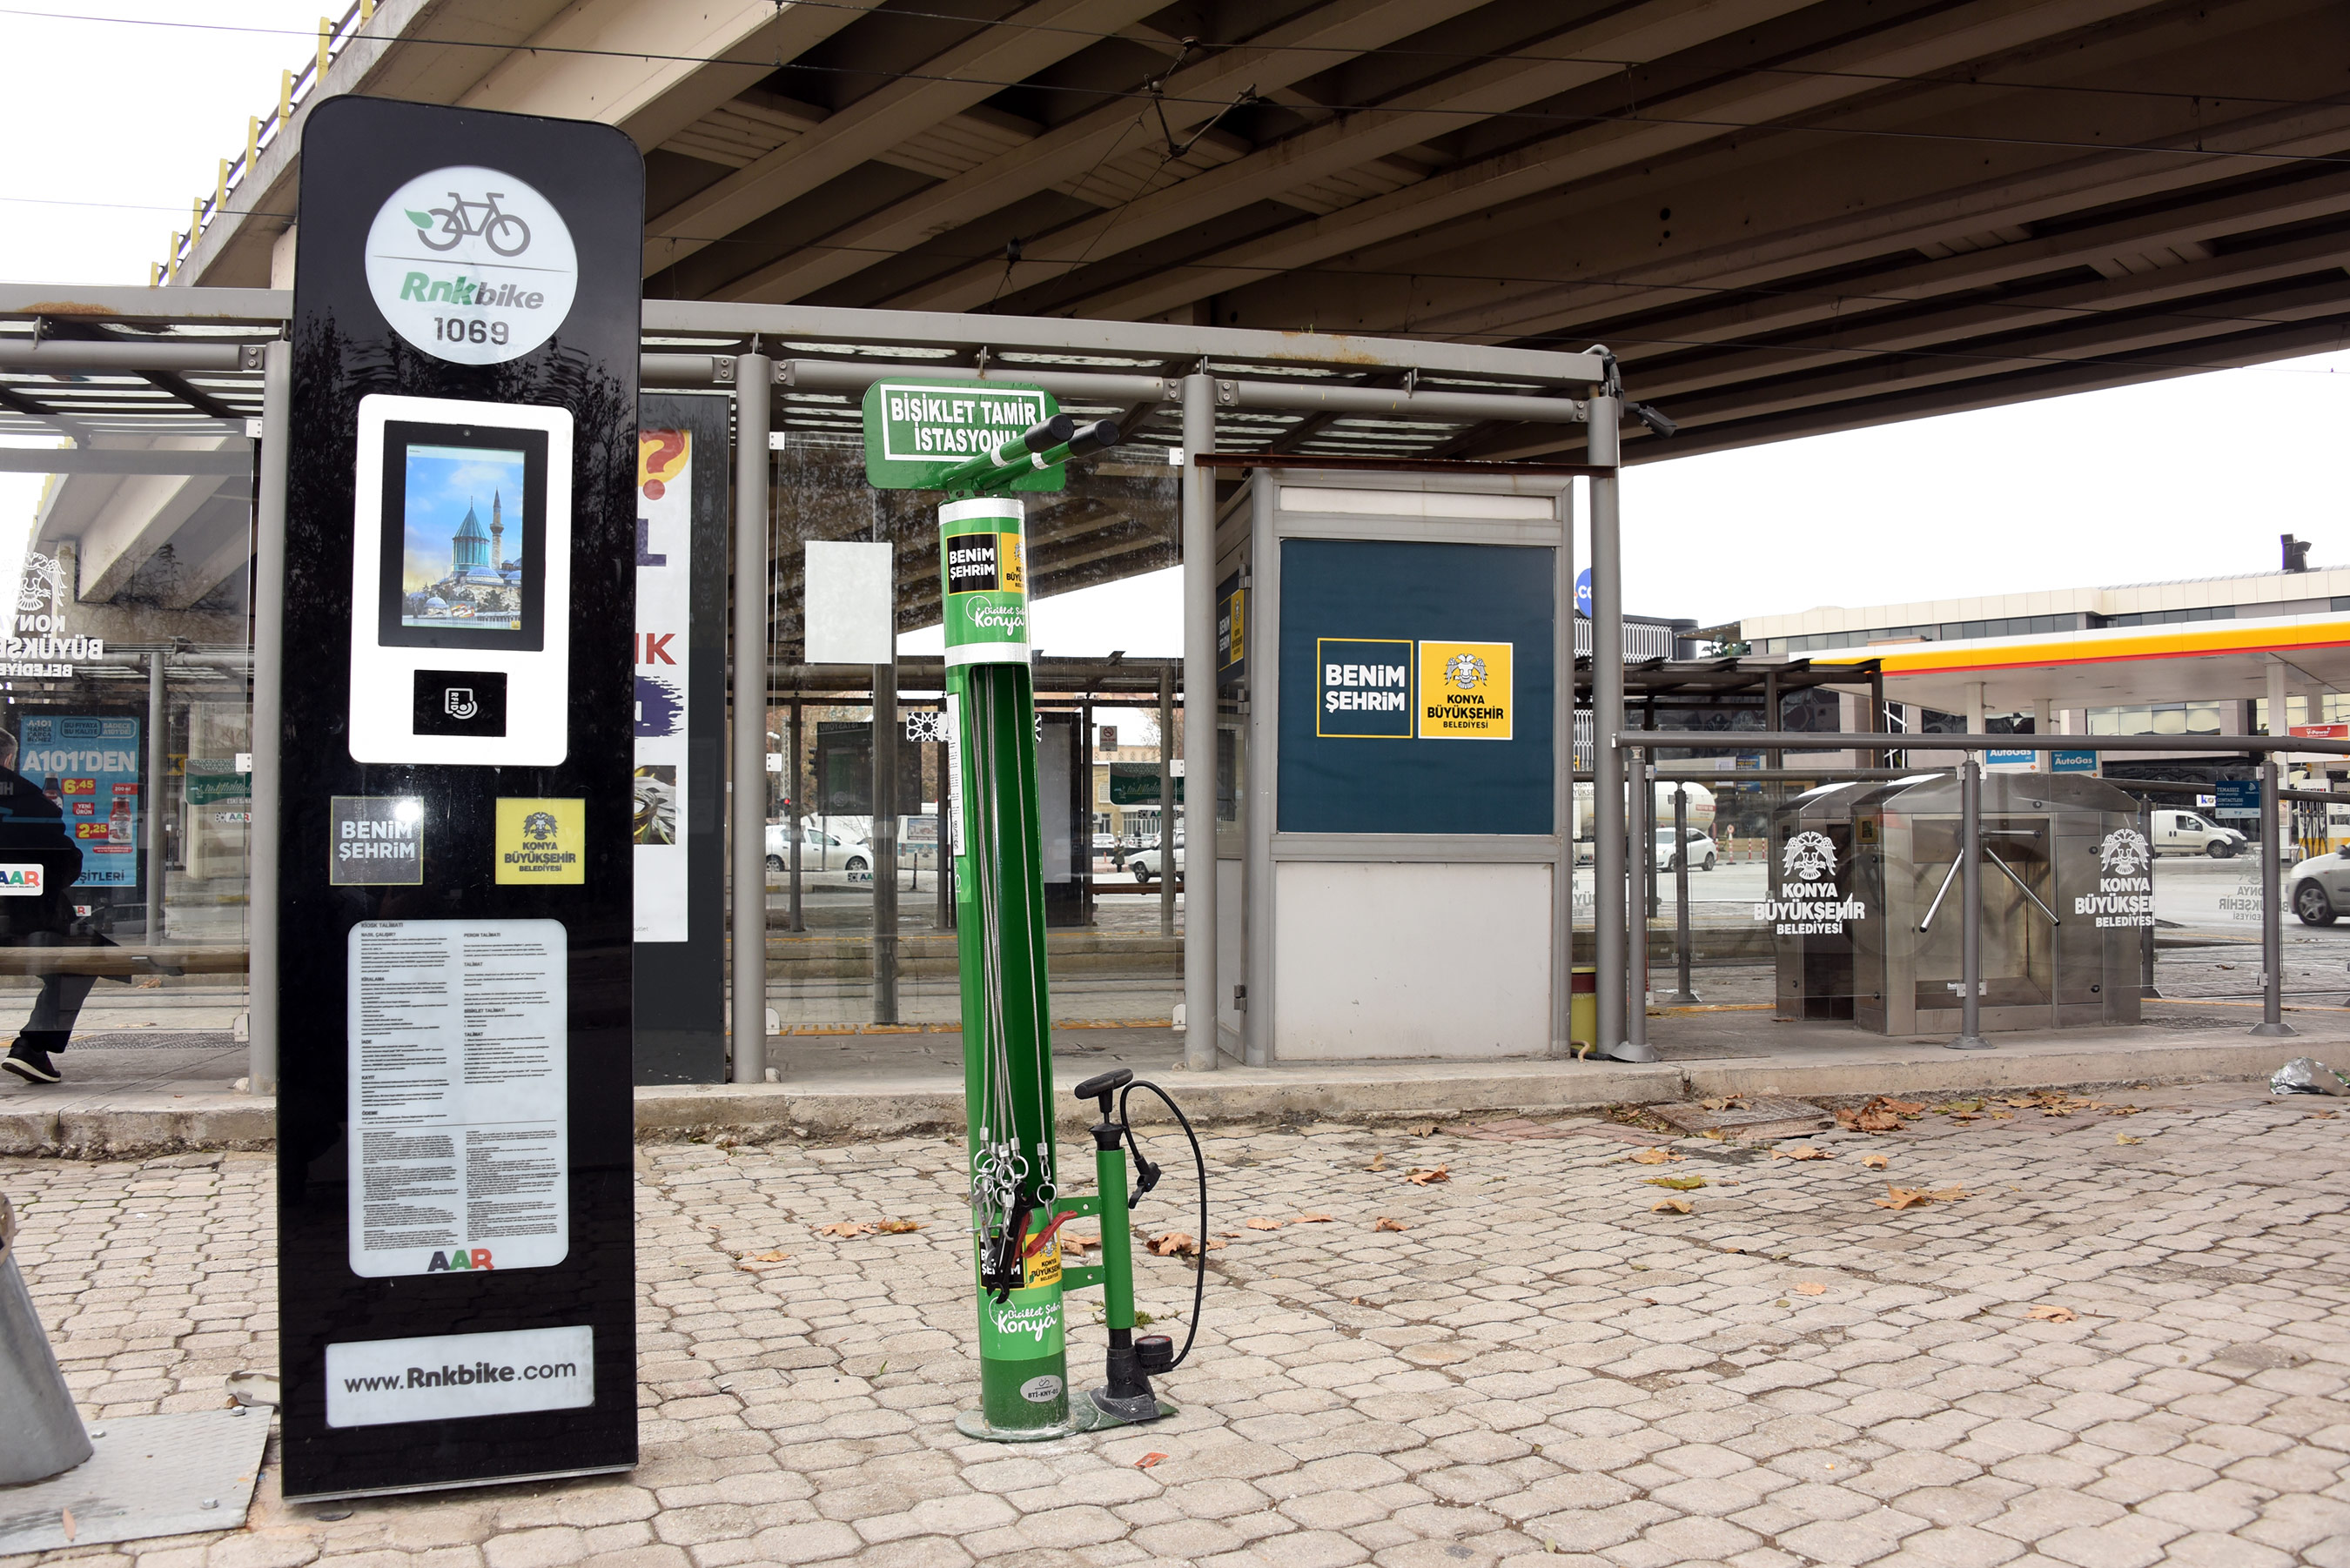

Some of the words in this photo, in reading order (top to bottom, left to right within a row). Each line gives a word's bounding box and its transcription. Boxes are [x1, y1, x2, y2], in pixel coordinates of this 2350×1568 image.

[400, 271, 544, 310] Rnkbike
[434, 317, 509, 345] 1069
[890, 392, 975, 424] BİSİKLET
[980, 397, 1037, 426] TAMİR
[950, 547, 995, 564] BENİM
[950, 564, 995, 580] ŞEHRİM
[975, 607, 1024, 635] Konya
[1326, 664, 1405, 687] BENİM
[450, 692, 459, 711] RFID
[1325, 690, 1405, 714] ŞEHRİM
[1447, 694, 1485, 705] KONYA
[1427, 704, 1504, 720] BÜYÜKŞEHİR
[1443, 720, 1488, 728] BELEDİYESİ
[22, 750, 135, 772] A101'DEN
[2055, 756, 2093, 765] AutoGas
[64, 779, 93, 794] 6,45
[78, 824, 106, 838] 2,25
[341, 821, 413, 840] BENİM
[339, 842, 415, 862] ŞEHRİM
[505, 851, 576, 865] BÜYÜKŞEHİR
[519, 863, 562, 872] BELEDİYESİ
[79, 869, 124, 884] ŞİTLERİ
[2100, 877, 2151, 892] KONYA
[1783, 882, 1838, 897] KONYA
[1754, 899, 1865, 922] BÜYÜKŞEHİR
[1776, 920, 1843, 935] BELEDİYESİ
[2096, 914, 2155, 927] BELEDİYESİ
[427, 1248, 494, 1272] AAR
[998, 1312, 1057, 1342] Konya
[345, 1361, 576, 1392] www.Rnkbike.com
